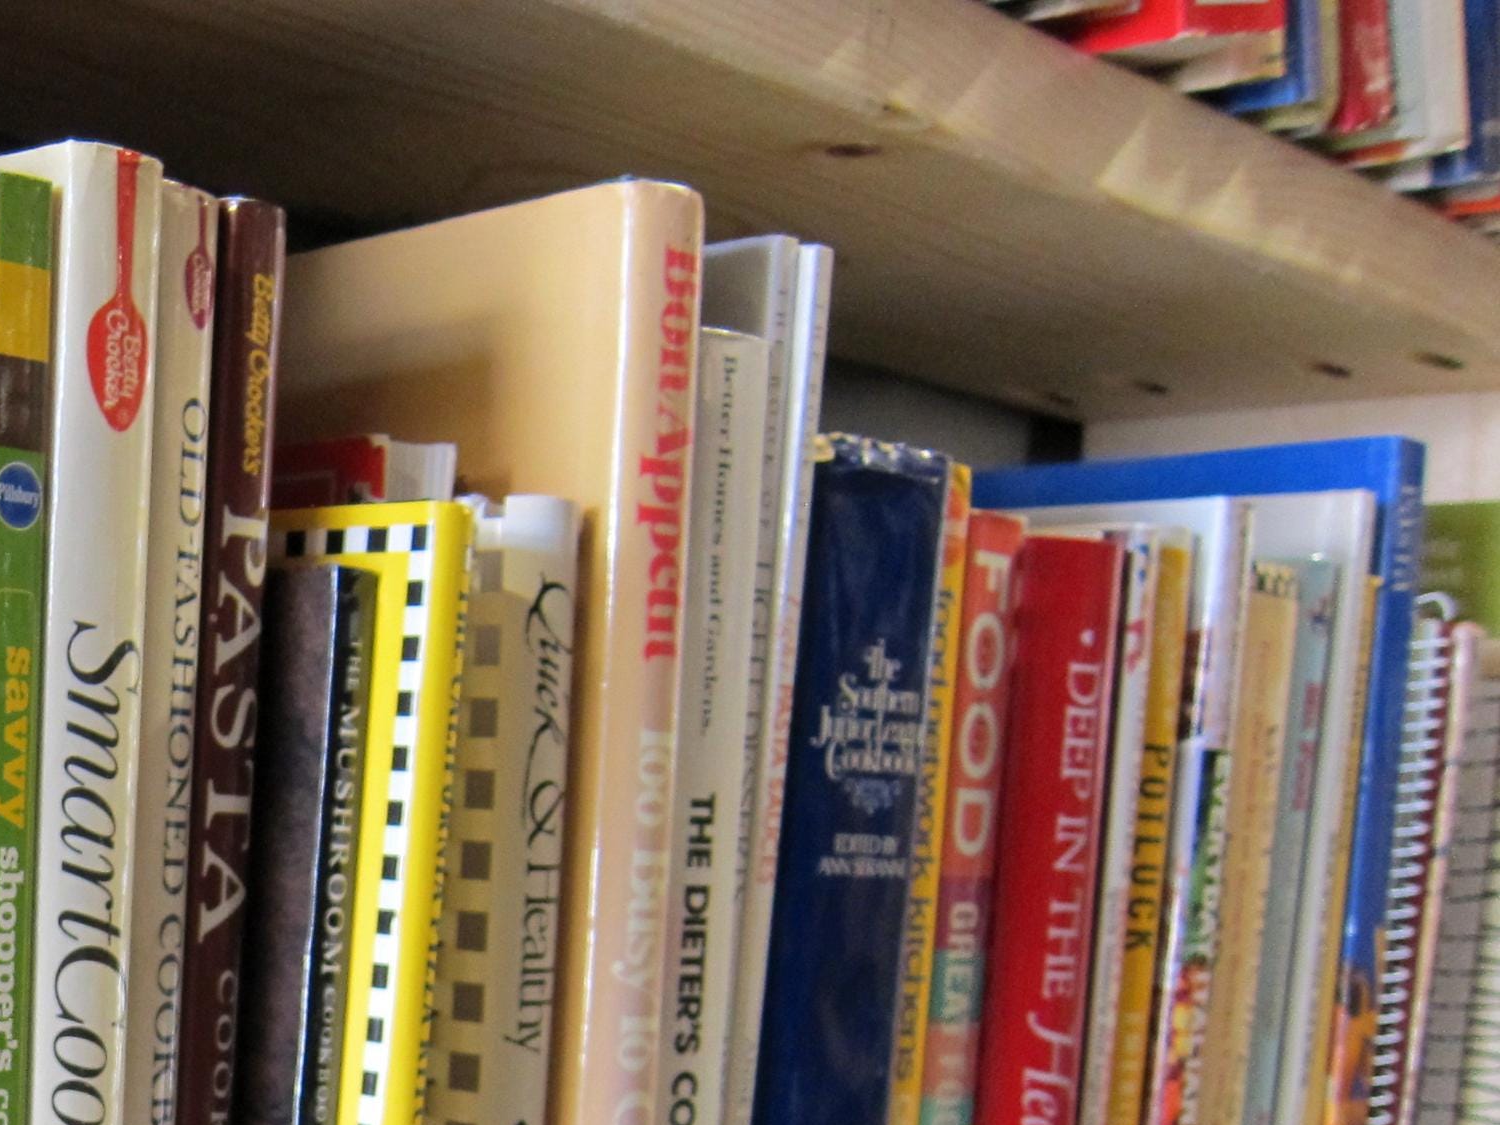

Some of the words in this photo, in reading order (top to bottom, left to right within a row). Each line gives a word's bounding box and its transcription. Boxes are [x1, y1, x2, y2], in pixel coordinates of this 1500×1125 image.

[105, 308, 128, 411] Crocker
[245, 273, 275, 352] Betty
[659, 247, 697, 390] Bon
[122, 333, 141, 402] Betty
[242, 350, 272, 475] Crocker's
[722, 355, 737, 440] Better
[714, 445, 732, 545] Homes
[708, 556, 722, 601] and
[162, 398, 206, 897] OLD-FASHIONED
[345, 640, 363, 691] THE
[524, 572, 572, 750] Quick
[198, 506, 269, 943] PASTA
[773, 684, 796, 766] PASTA
[953, 550, 1011, 858] FOOD
[1060, 662, 1100, 800] DEEP
[527, 779, 566, 850] &
[637, 731, 672, 828] Too
[685, 793, 715, 868] THE
[756, 777, 785, 886] SAUCES
[319, 704, 361, 975] MUSHROOM
[1054, 815, 1088, 875] IN
[1124, 744, 1174, 951] POTLUCK
[505, 861, 559, 1054] Healthy
[611, 849, 670, 992] Busy
[672, 885, 711, 1056] DIETER'S
[942, 902, 980, 1040] GREAT
[1041, 896, 1082, 1000] THE
[617, 1015, 659, 1072] To
